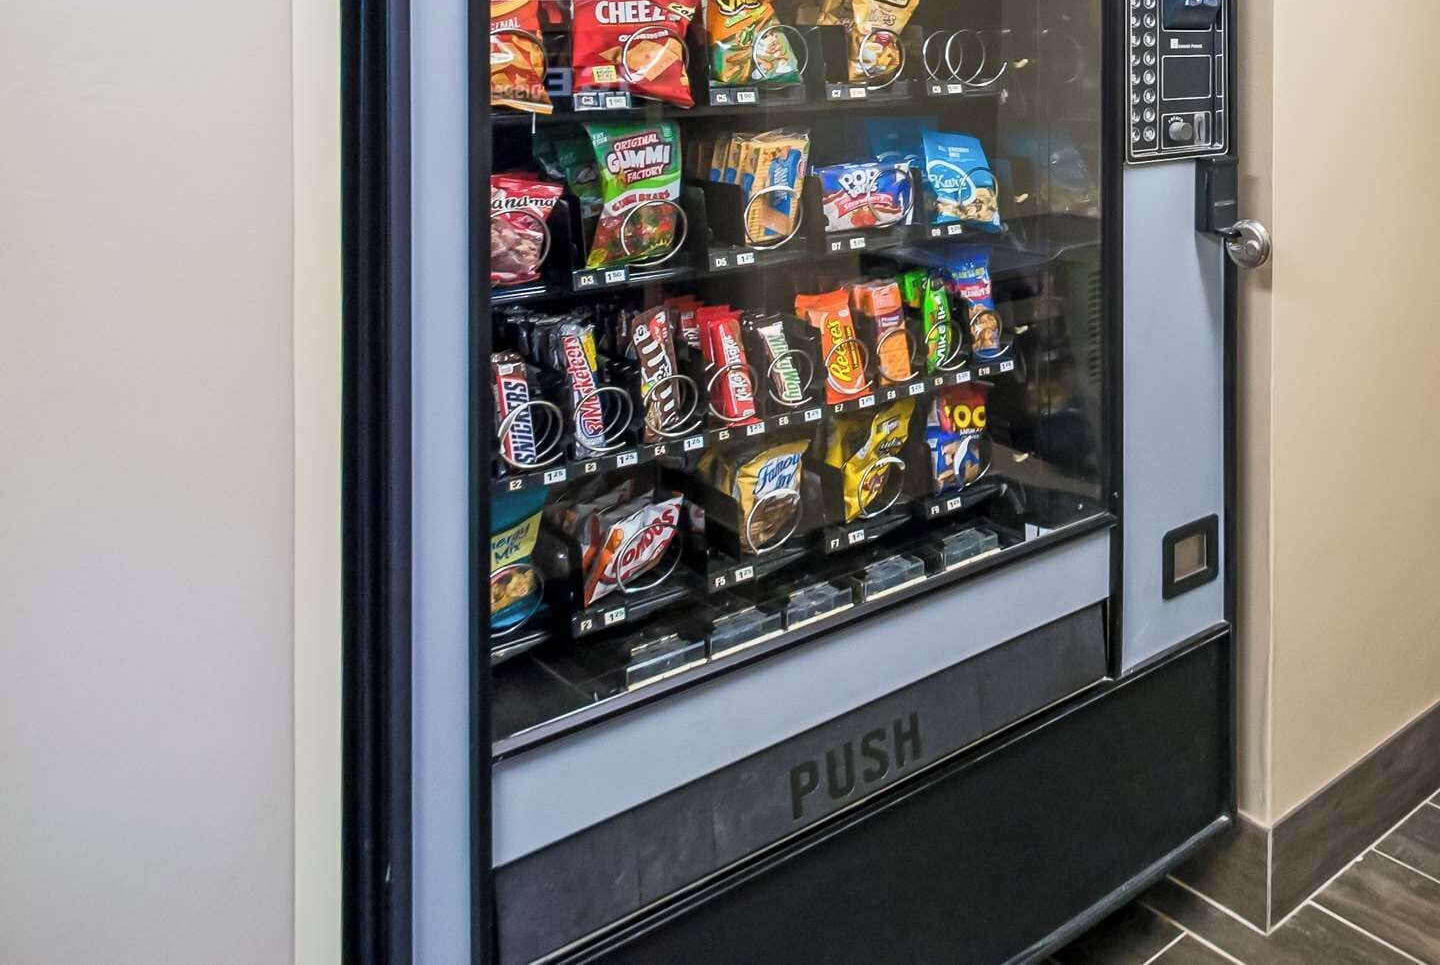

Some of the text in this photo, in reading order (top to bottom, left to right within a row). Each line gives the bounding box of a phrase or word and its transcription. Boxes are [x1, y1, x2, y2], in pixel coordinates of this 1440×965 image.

[614, 134, 659, 151] ORIGINAL
[607, 144, 671, 173] GUMMI
[627, 164, 664, 183] FACTORY
[639, 189, 670, 201] BEARS
[492, 195, 558, 209] andma
[767, 332, 803, 401] Milky Way
[563, 335, 604, 425] Musketeers
[834, 404, 844, 412] E7
[504, 381, 536, 464] SNICKERS
[779, 416, 789, 425] E6
[719, 430, 730, 440] E5
[654, 445, 666, 456] E4
[584, 462, 597, 473] E3
[752, 453, 800, 494] Famou
[509, 480, 522, 491] E2
[830, 538, 840, 548] F7
[715, 576, 726, 587] F5
[580, 620, 593, 631] F3
[789, 711, 923, 820] PUSH
